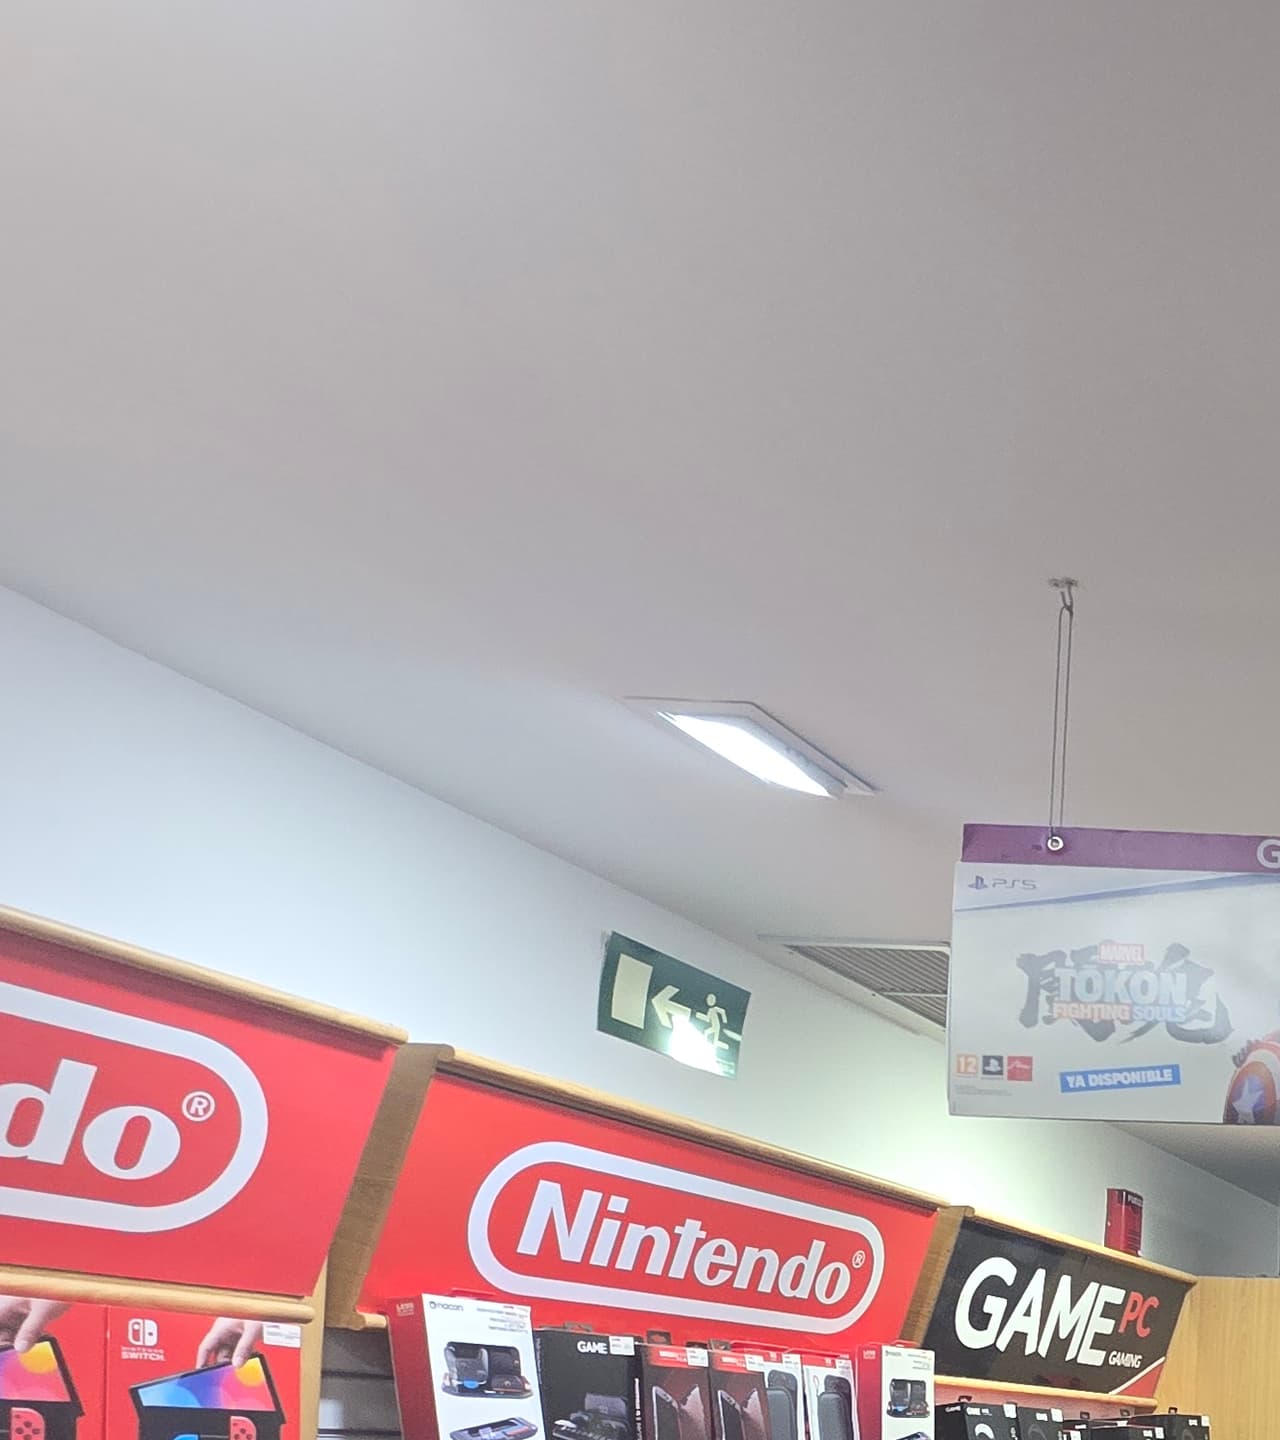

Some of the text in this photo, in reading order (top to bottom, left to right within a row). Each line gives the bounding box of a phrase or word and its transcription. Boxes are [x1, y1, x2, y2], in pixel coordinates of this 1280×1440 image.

[992, 878, 1037, 890] PS5
[1099, 944, 1143, 962] MARVEL
[1053, 1003, 1187, 1022] FIGHTING SOULS
[1066, 1067, 1173, 1088] YA DISPONIBLE
[516, 1179, 851, 1305] Nintendo
[954, 1256, 1160, 1367] GAME PC
[577, 1340, 608, 1354] GAME
[1108, 1350, 1142, 1369] GAMING
